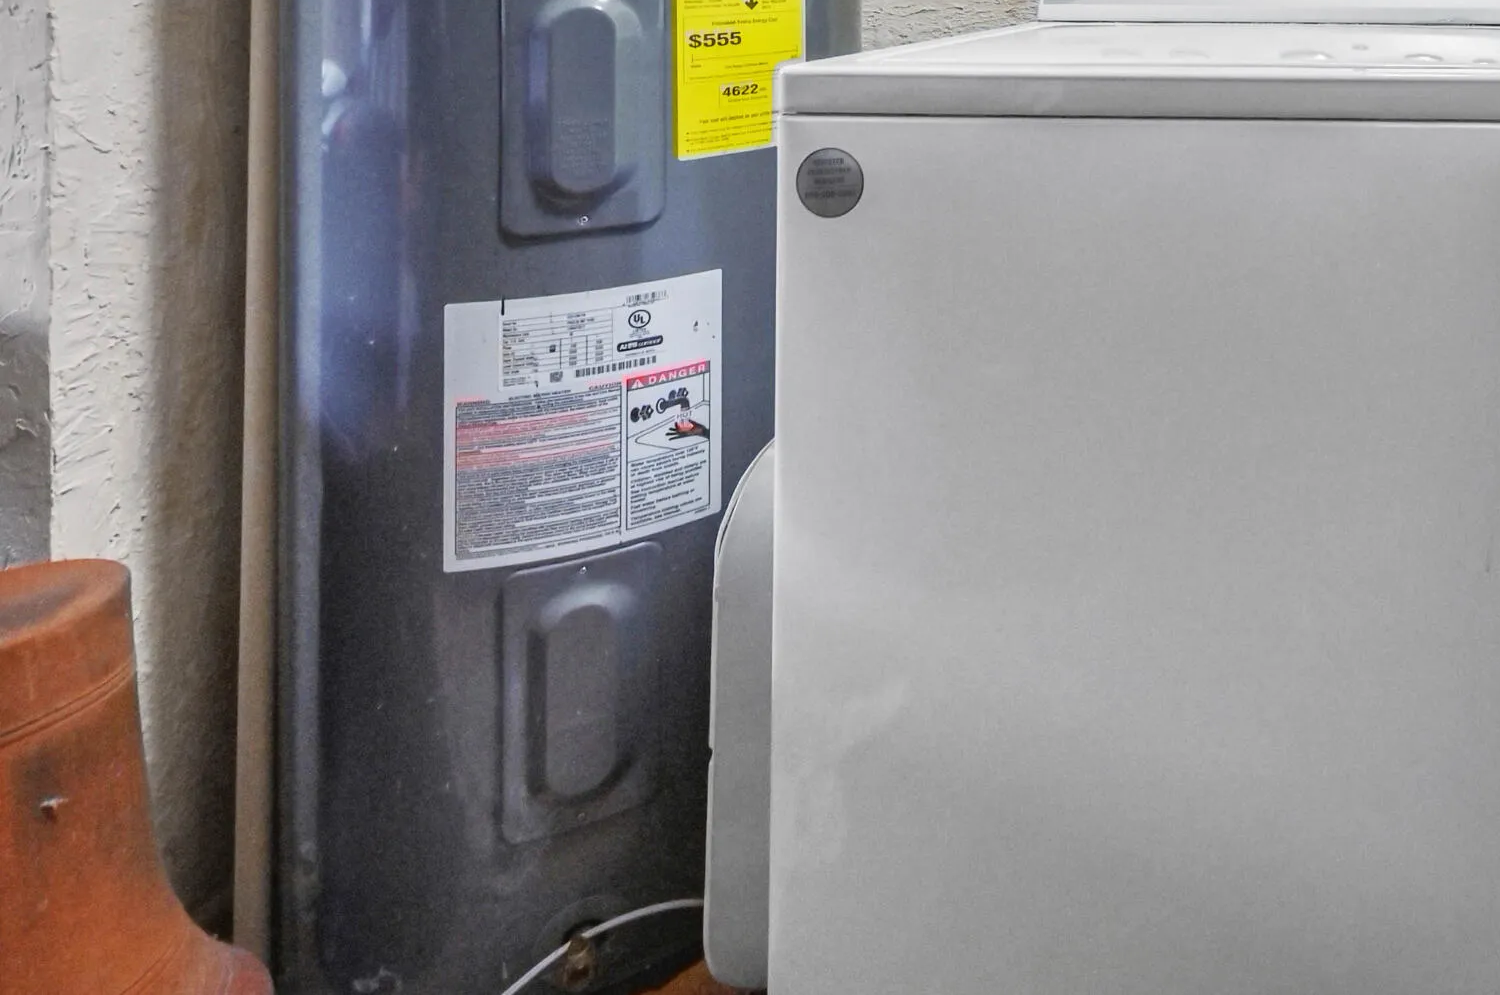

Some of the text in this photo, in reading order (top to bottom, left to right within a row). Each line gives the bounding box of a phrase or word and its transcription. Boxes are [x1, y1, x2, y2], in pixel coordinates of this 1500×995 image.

[688, 31, 742, 49] $555
[722, 83, 758, 97] 4622
[633, 314, 645, 324] UL
[648, 363, 706, 385] DANGER
